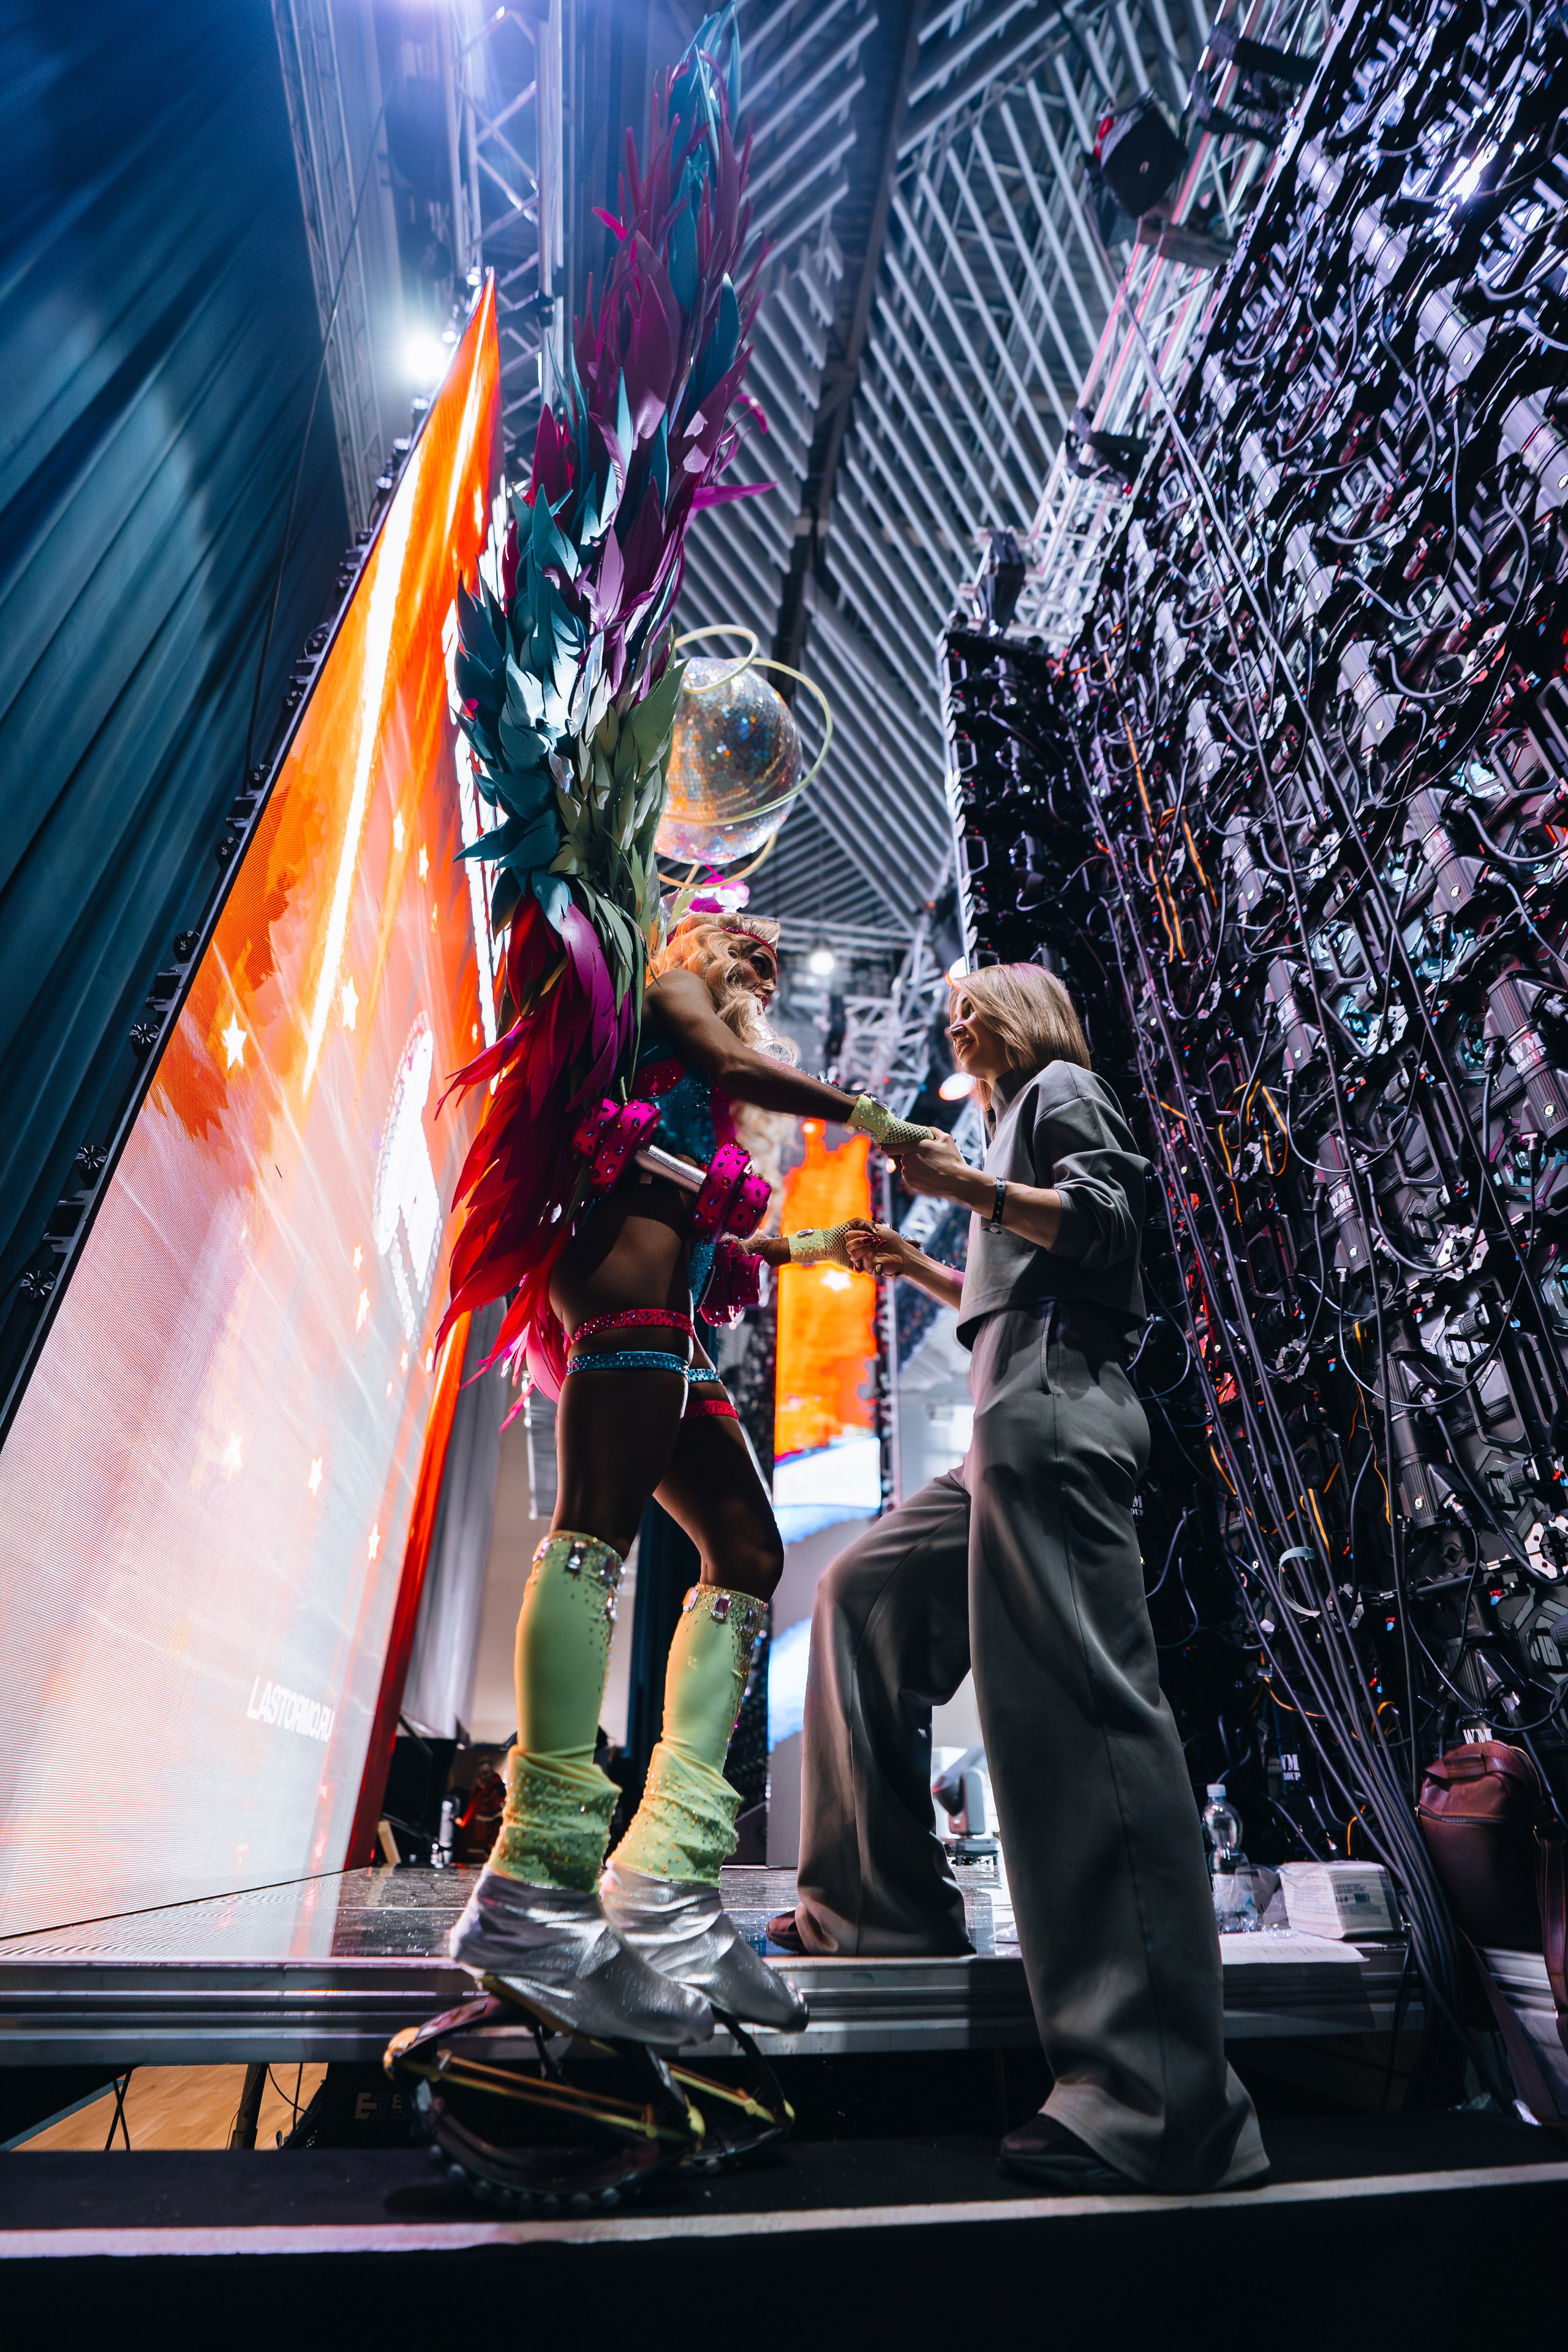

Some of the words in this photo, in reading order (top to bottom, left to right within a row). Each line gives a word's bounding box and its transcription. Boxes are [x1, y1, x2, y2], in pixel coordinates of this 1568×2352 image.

[1509, 1031, 1544, 1064] WM
[1516, 1046, 1547, 1074] GROUP
[1329, 1185, 1352, 1210] WM
[1463, 1728, 1493, 1745] WM
